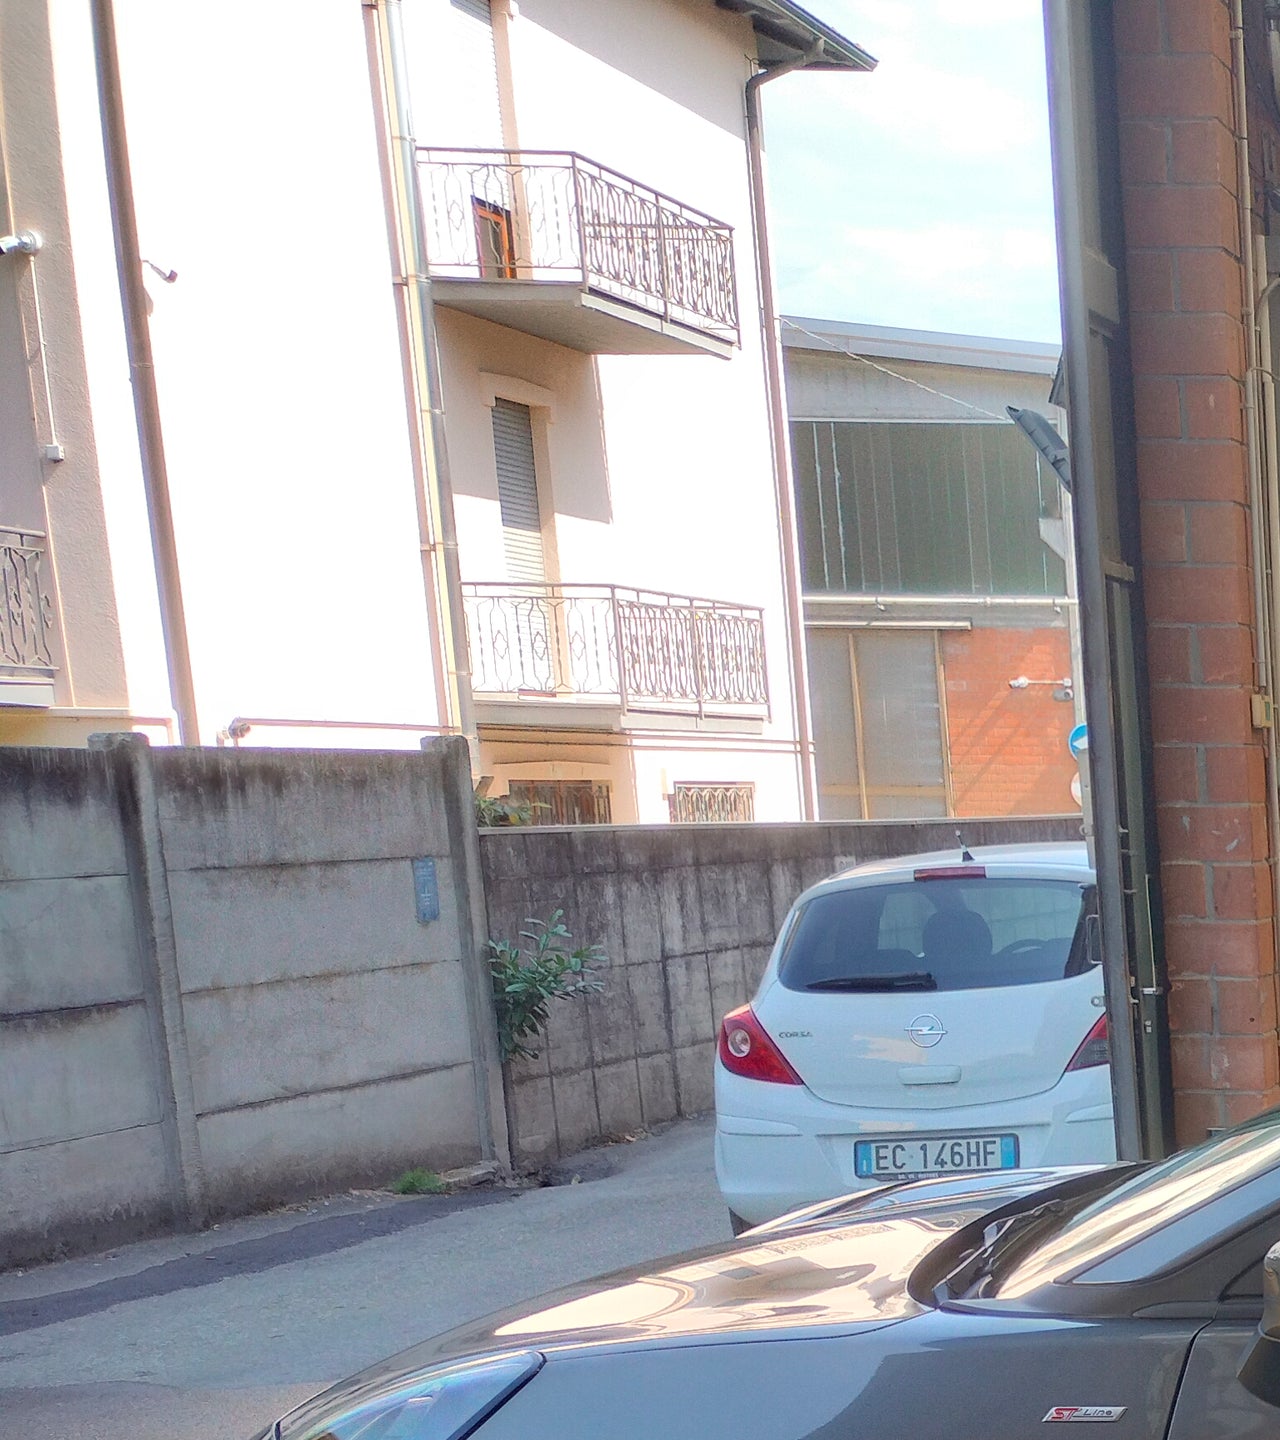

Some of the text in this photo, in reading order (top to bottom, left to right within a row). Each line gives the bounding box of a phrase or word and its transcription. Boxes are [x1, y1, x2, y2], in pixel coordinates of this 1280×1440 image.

[875, 1140, 997, 1171] EC 146HF
[1050, 1407, 1080, 1421] ST
